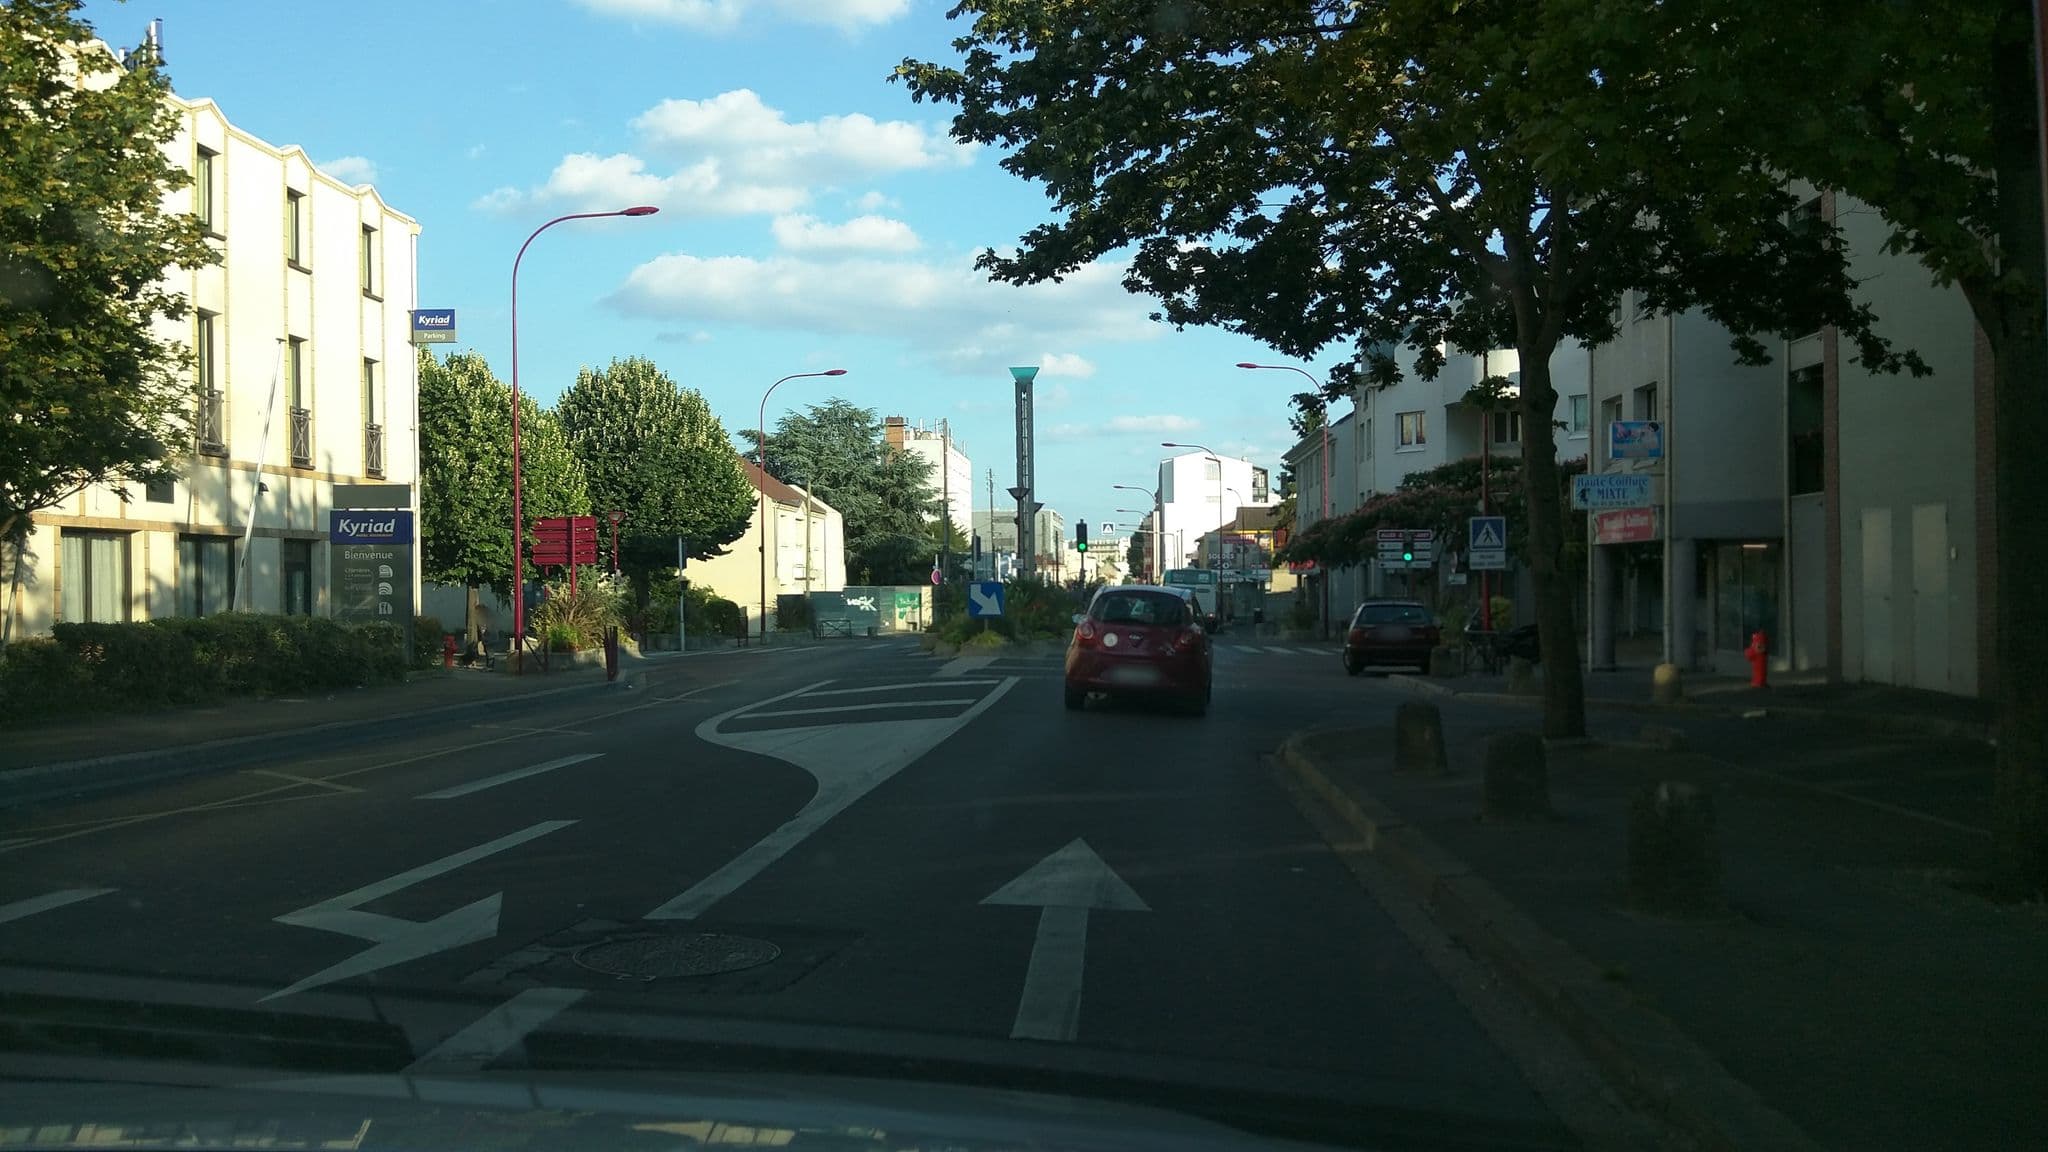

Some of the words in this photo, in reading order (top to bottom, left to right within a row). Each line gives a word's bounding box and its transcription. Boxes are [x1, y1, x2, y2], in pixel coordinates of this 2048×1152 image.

[418, 315, 450, 326] Kyriad
[423, 332, 446, 340] Parking
[1577, 477, 1606, 487] Haute
[1609, 476, 1648, 487] Coiffure
[1597, 487, 1627, 499] MIXTE
[338, 518, 396, 536] Kyriad
[344, 551, 393, 560] Bienvenue
